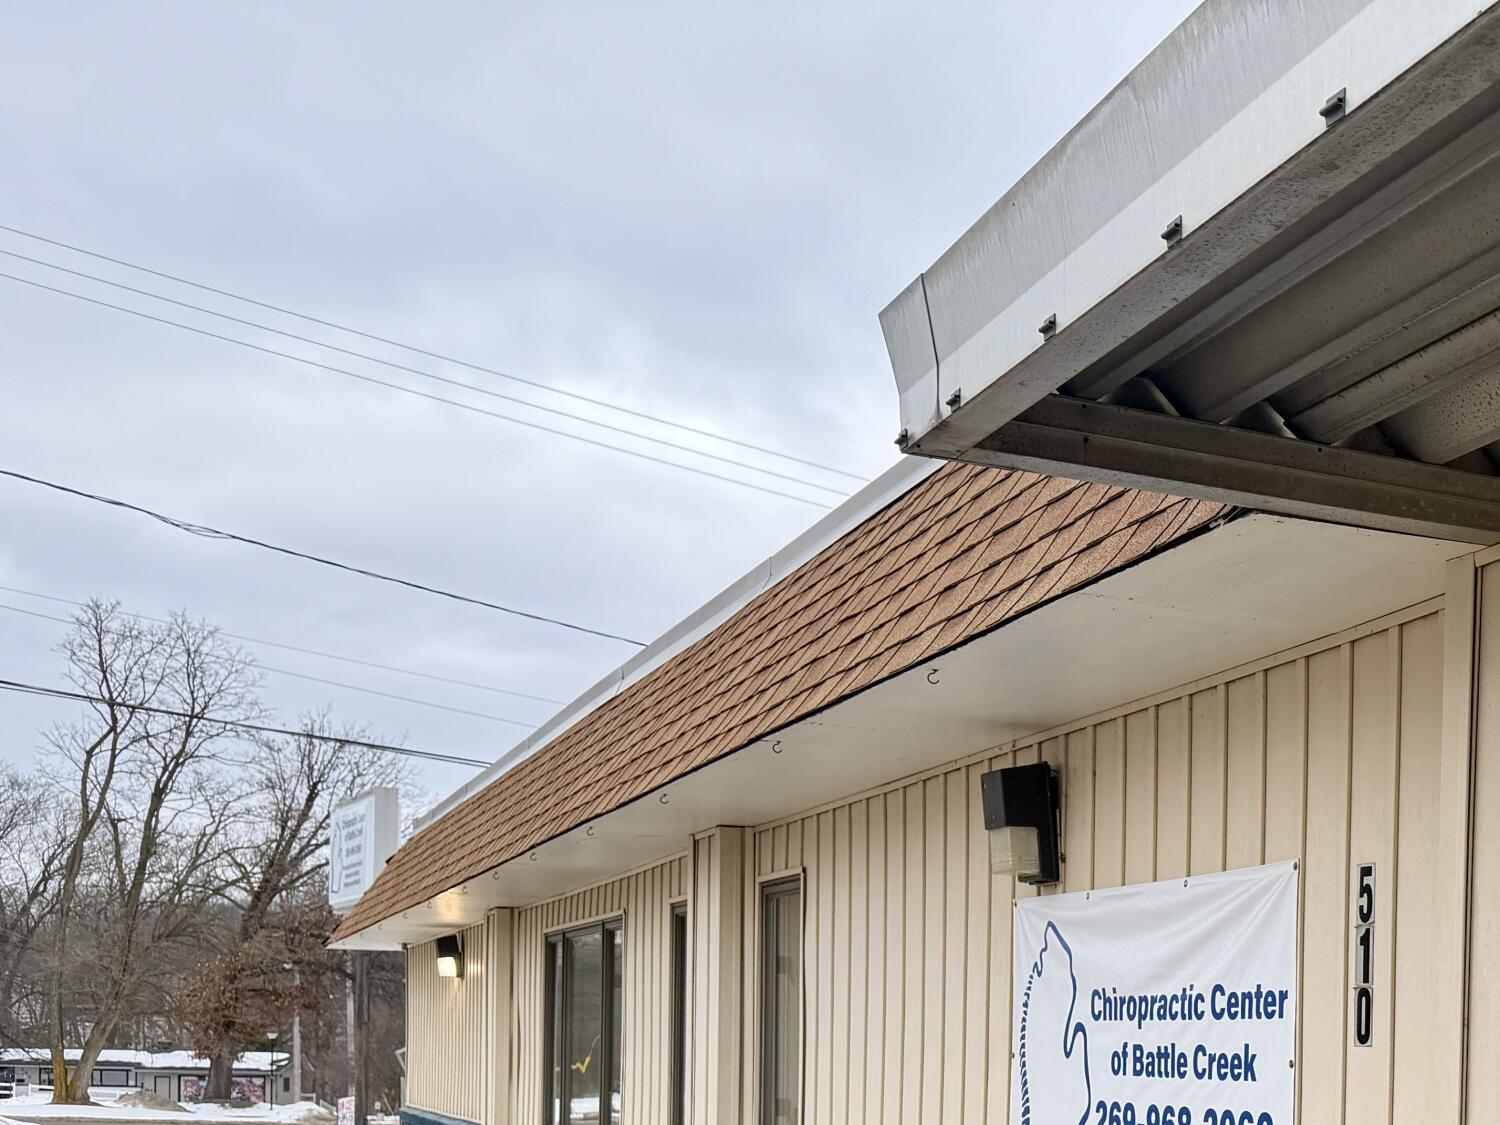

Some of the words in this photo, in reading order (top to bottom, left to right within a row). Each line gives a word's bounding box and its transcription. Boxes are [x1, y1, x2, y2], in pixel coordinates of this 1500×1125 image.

[1356, 865, 1374, 1046] 510
[1090, 984, 1206, 1030] Chiropractic
[1210, 983, 1289, 1022] Center
[1111, 1042, 1129, 1077] of
[1132, 1043, 1188, 1079] Battle
[1193, 1043, 1257, 1082] Creek
